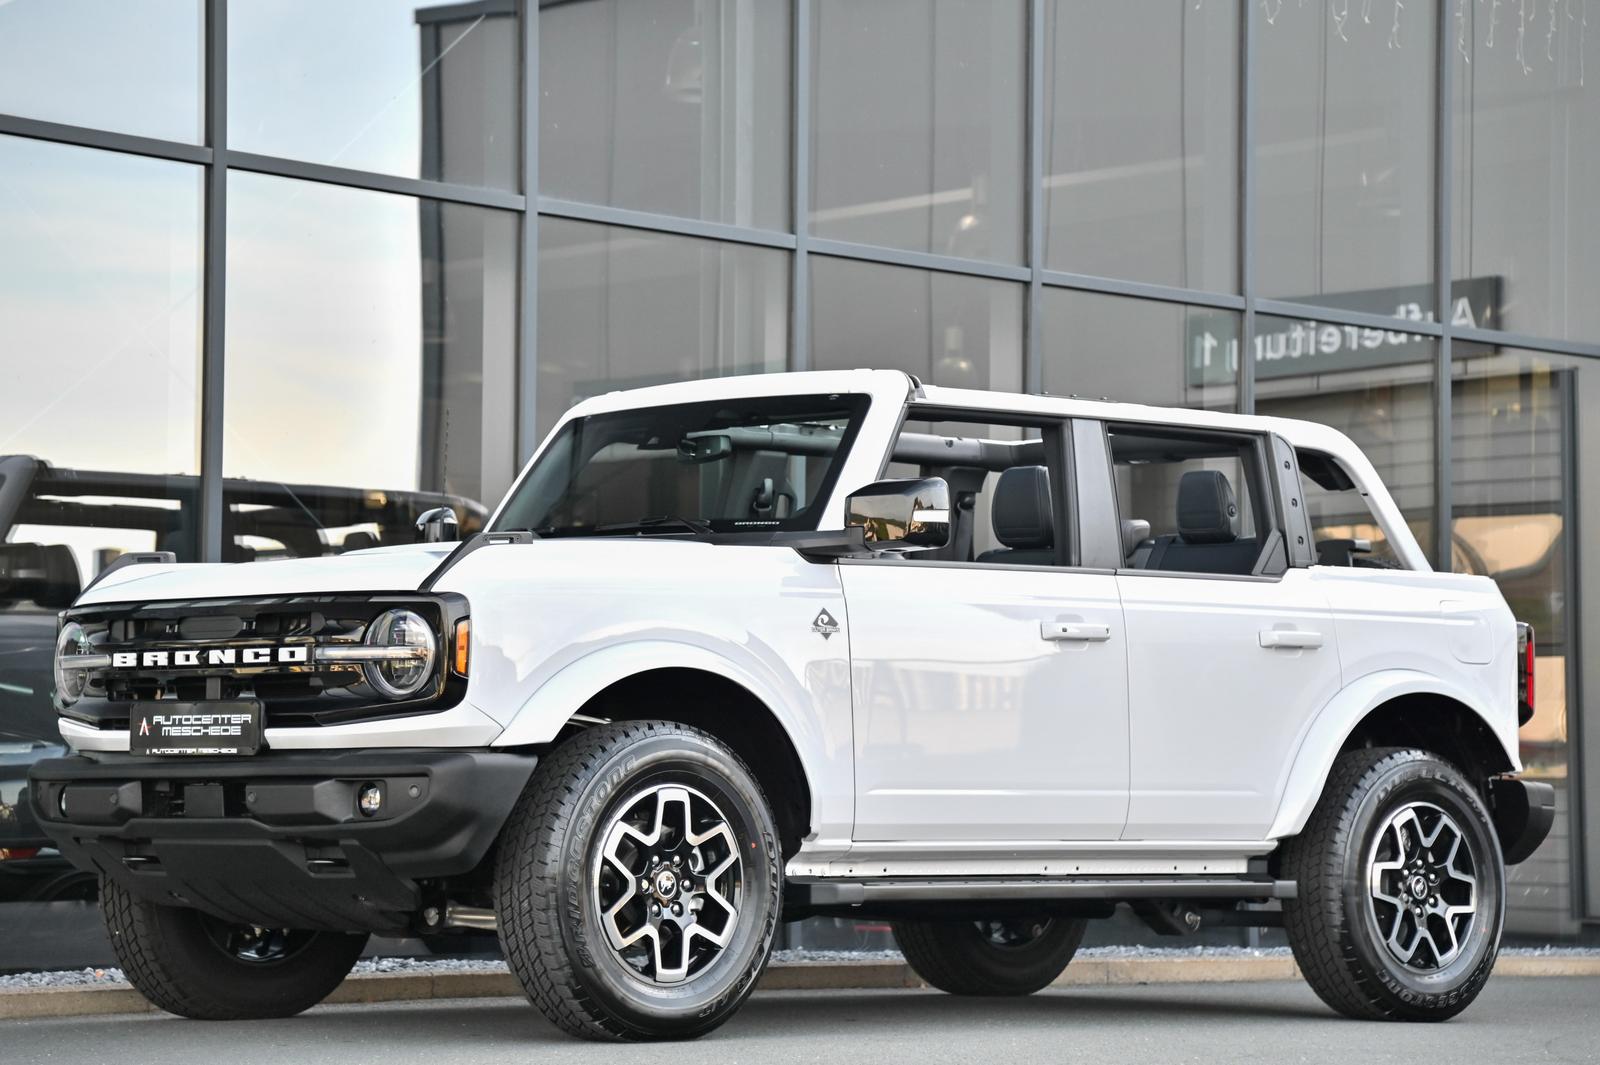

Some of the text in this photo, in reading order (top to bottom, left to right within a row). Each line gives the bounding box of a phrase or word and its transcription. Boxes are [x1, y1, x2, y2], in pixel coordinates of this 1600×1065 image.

[112, 646, 307, 667] BRONCO
[152, 714, 252, 725] AUTOCENTER
[162, 726, 242, 736] MESCHEDE
